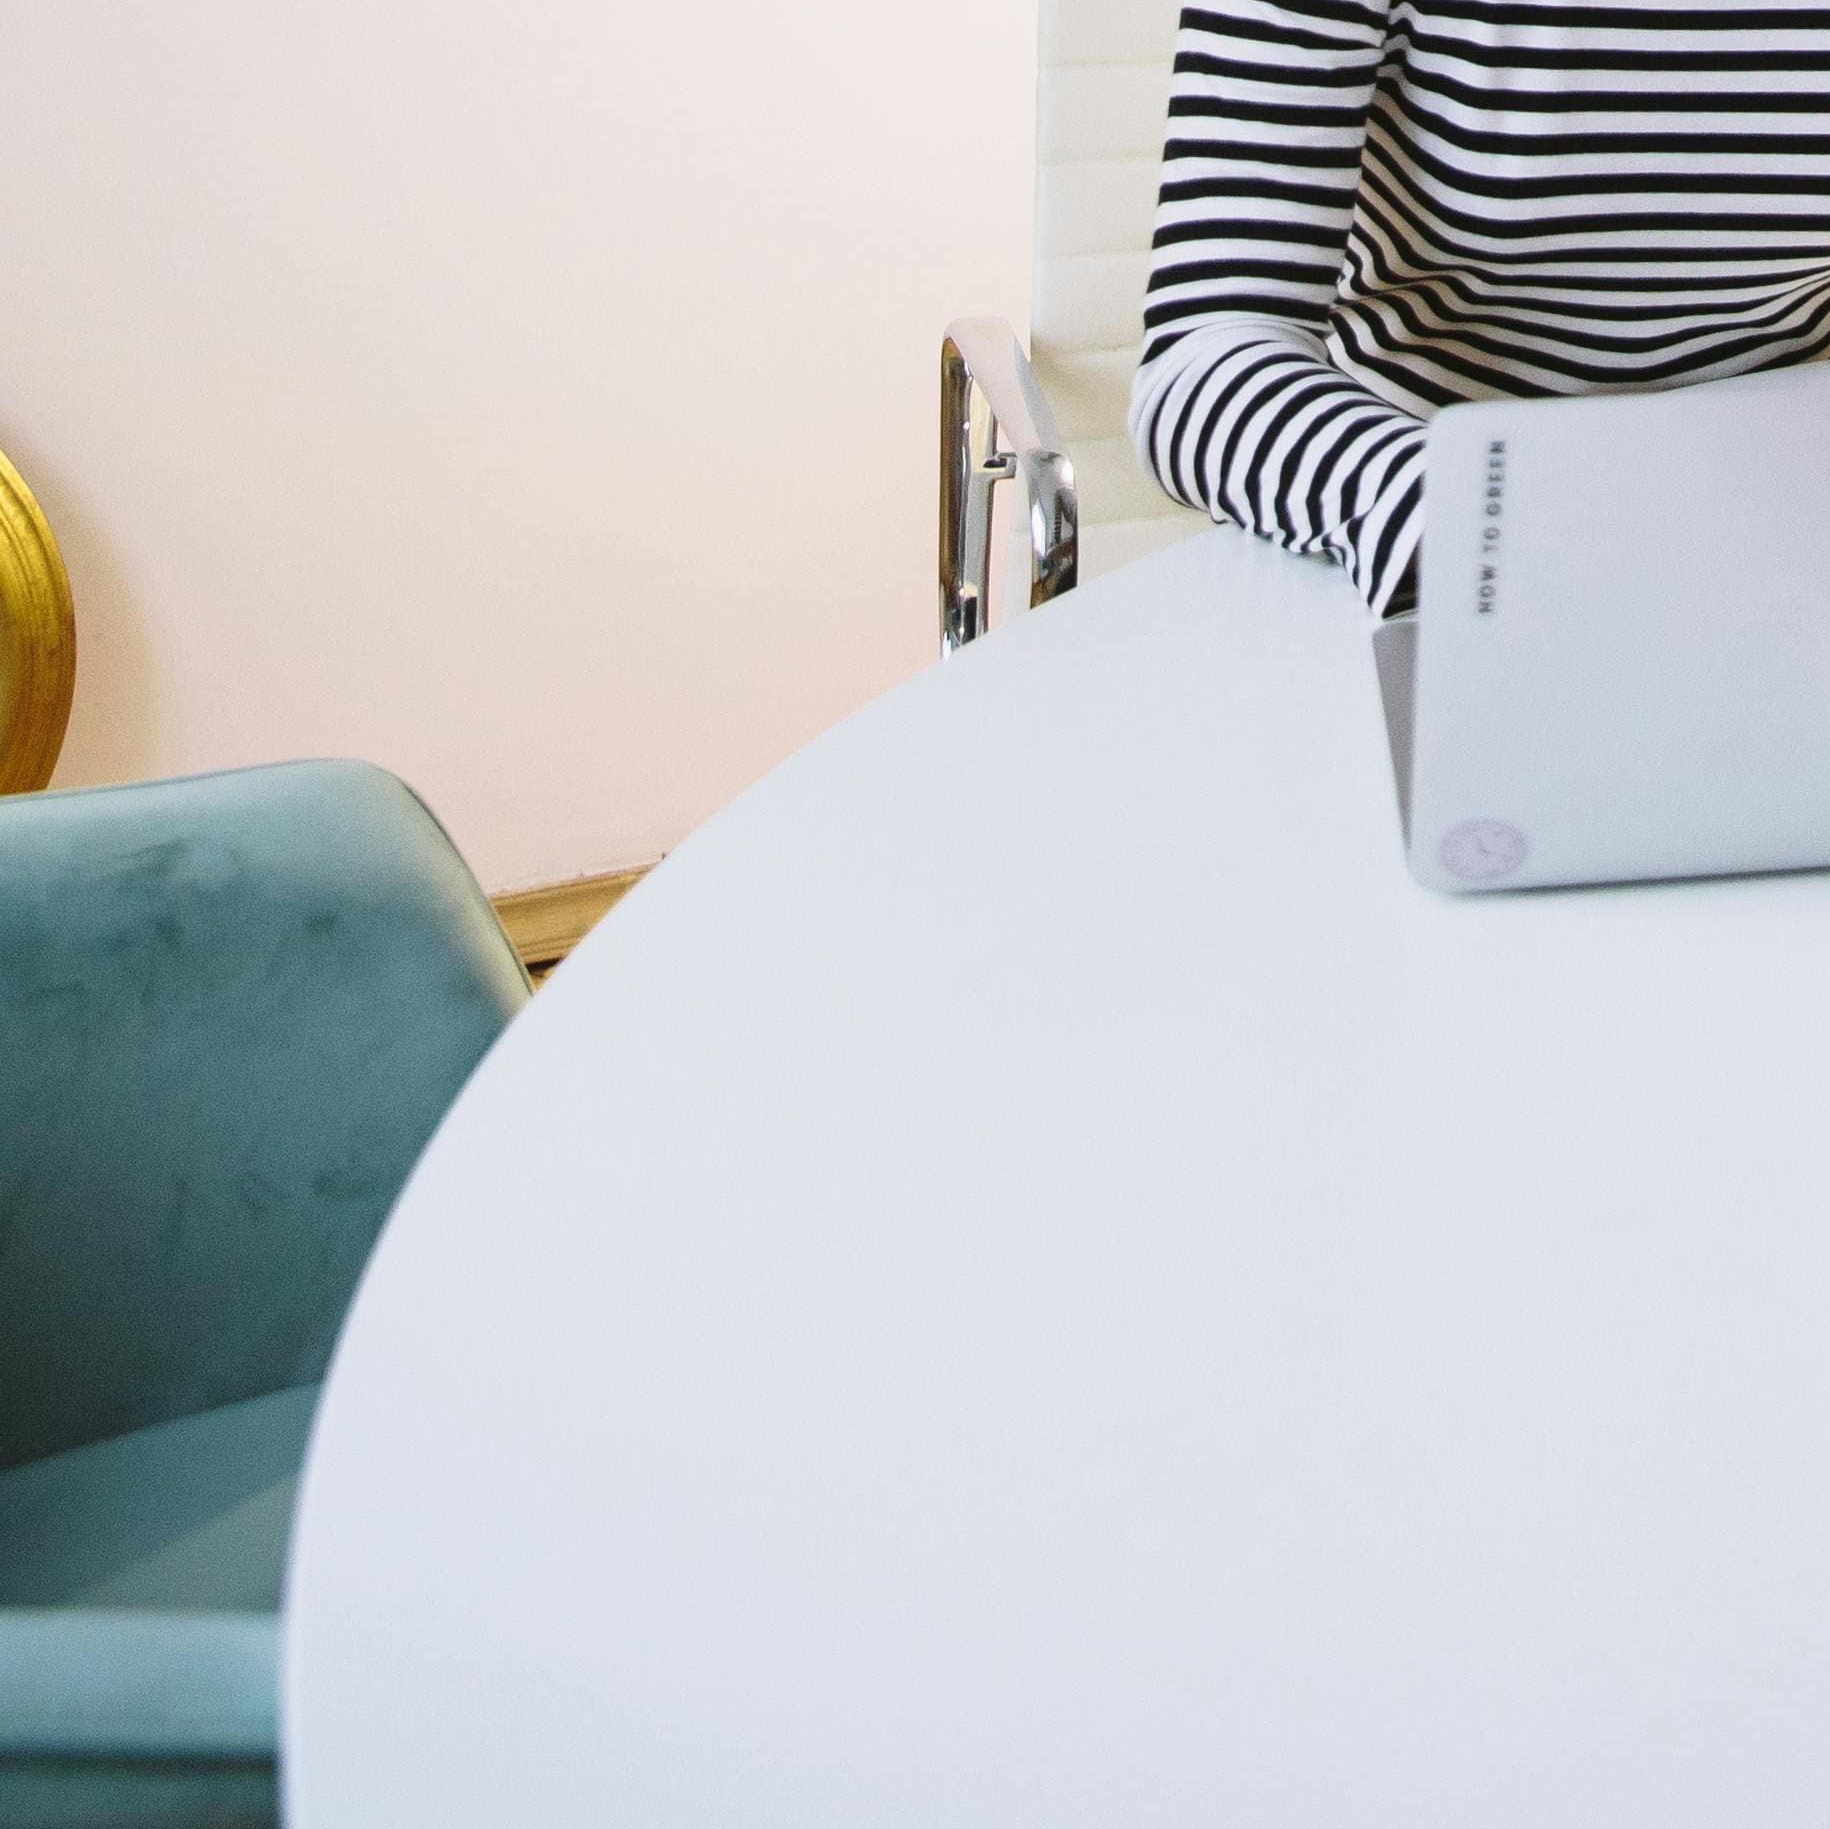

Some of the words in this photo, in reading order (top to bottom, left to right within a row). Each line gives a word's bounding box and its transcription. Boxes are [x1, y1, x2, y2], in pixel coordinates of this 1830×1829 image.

[1485, 440, 1506, 517] GREEN
[1482, 525, 1501, 553] TO
[1478, 565, 1497, 614] HOW
